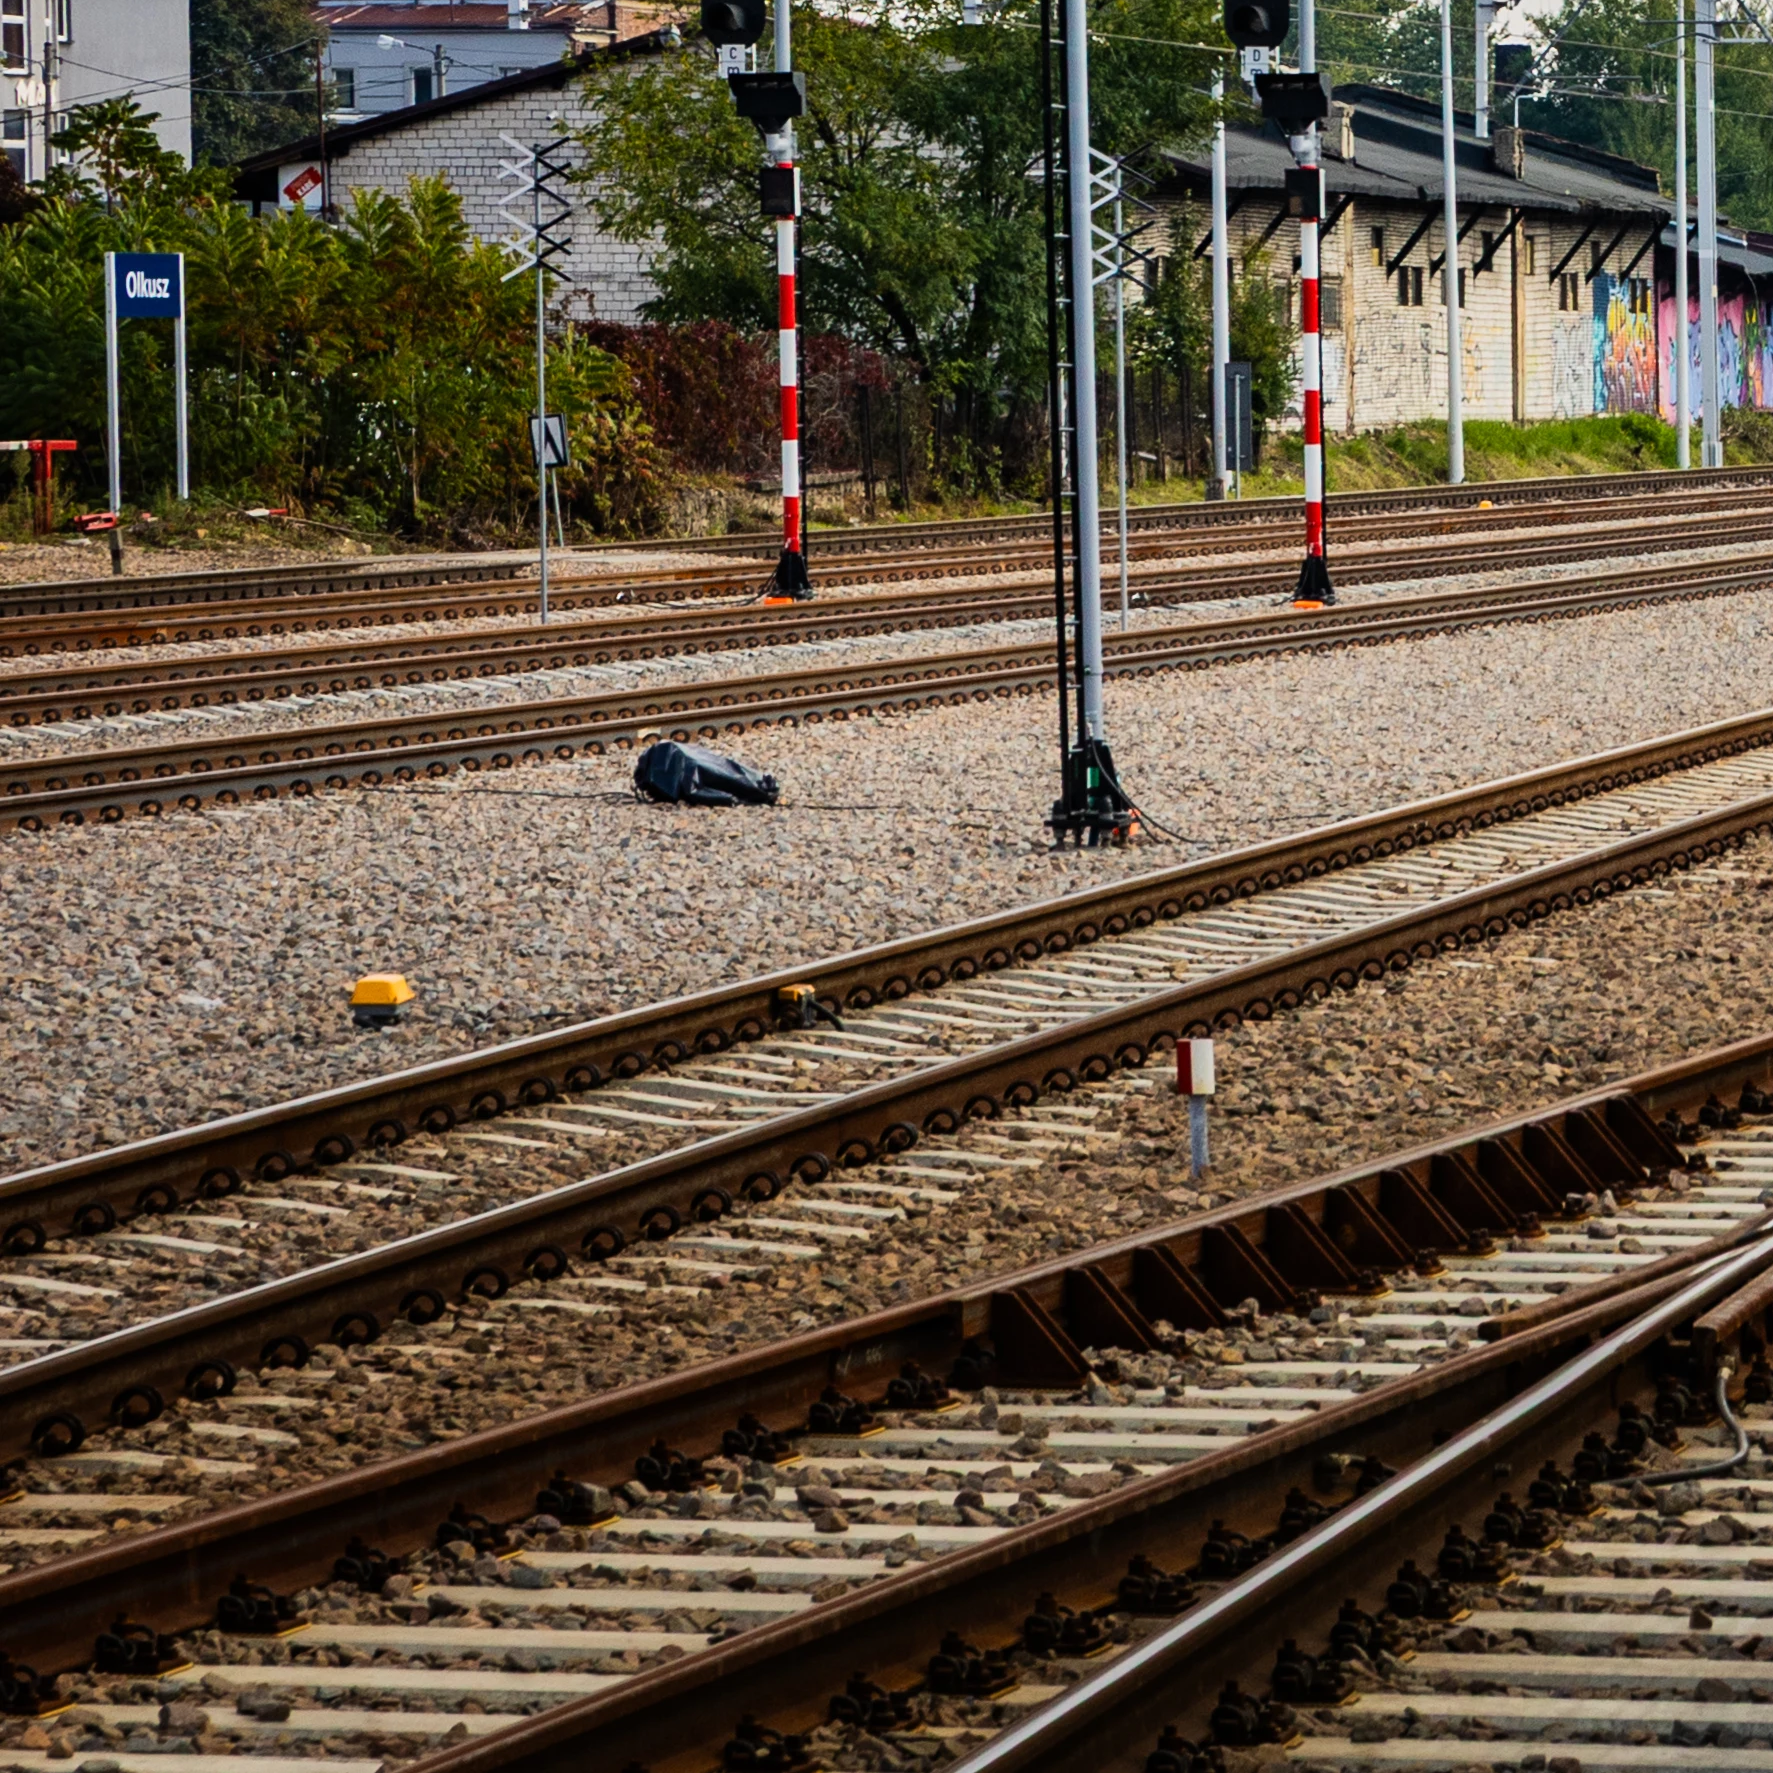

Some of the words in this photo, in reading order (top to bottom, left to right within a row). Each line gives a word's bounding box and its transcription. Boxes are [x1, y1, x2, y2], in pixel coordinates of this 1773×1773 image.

[729, 47, 737, 59] C
[1253, 49, 1261, 62] D
[125, 271, 170, 299] Olkusz
